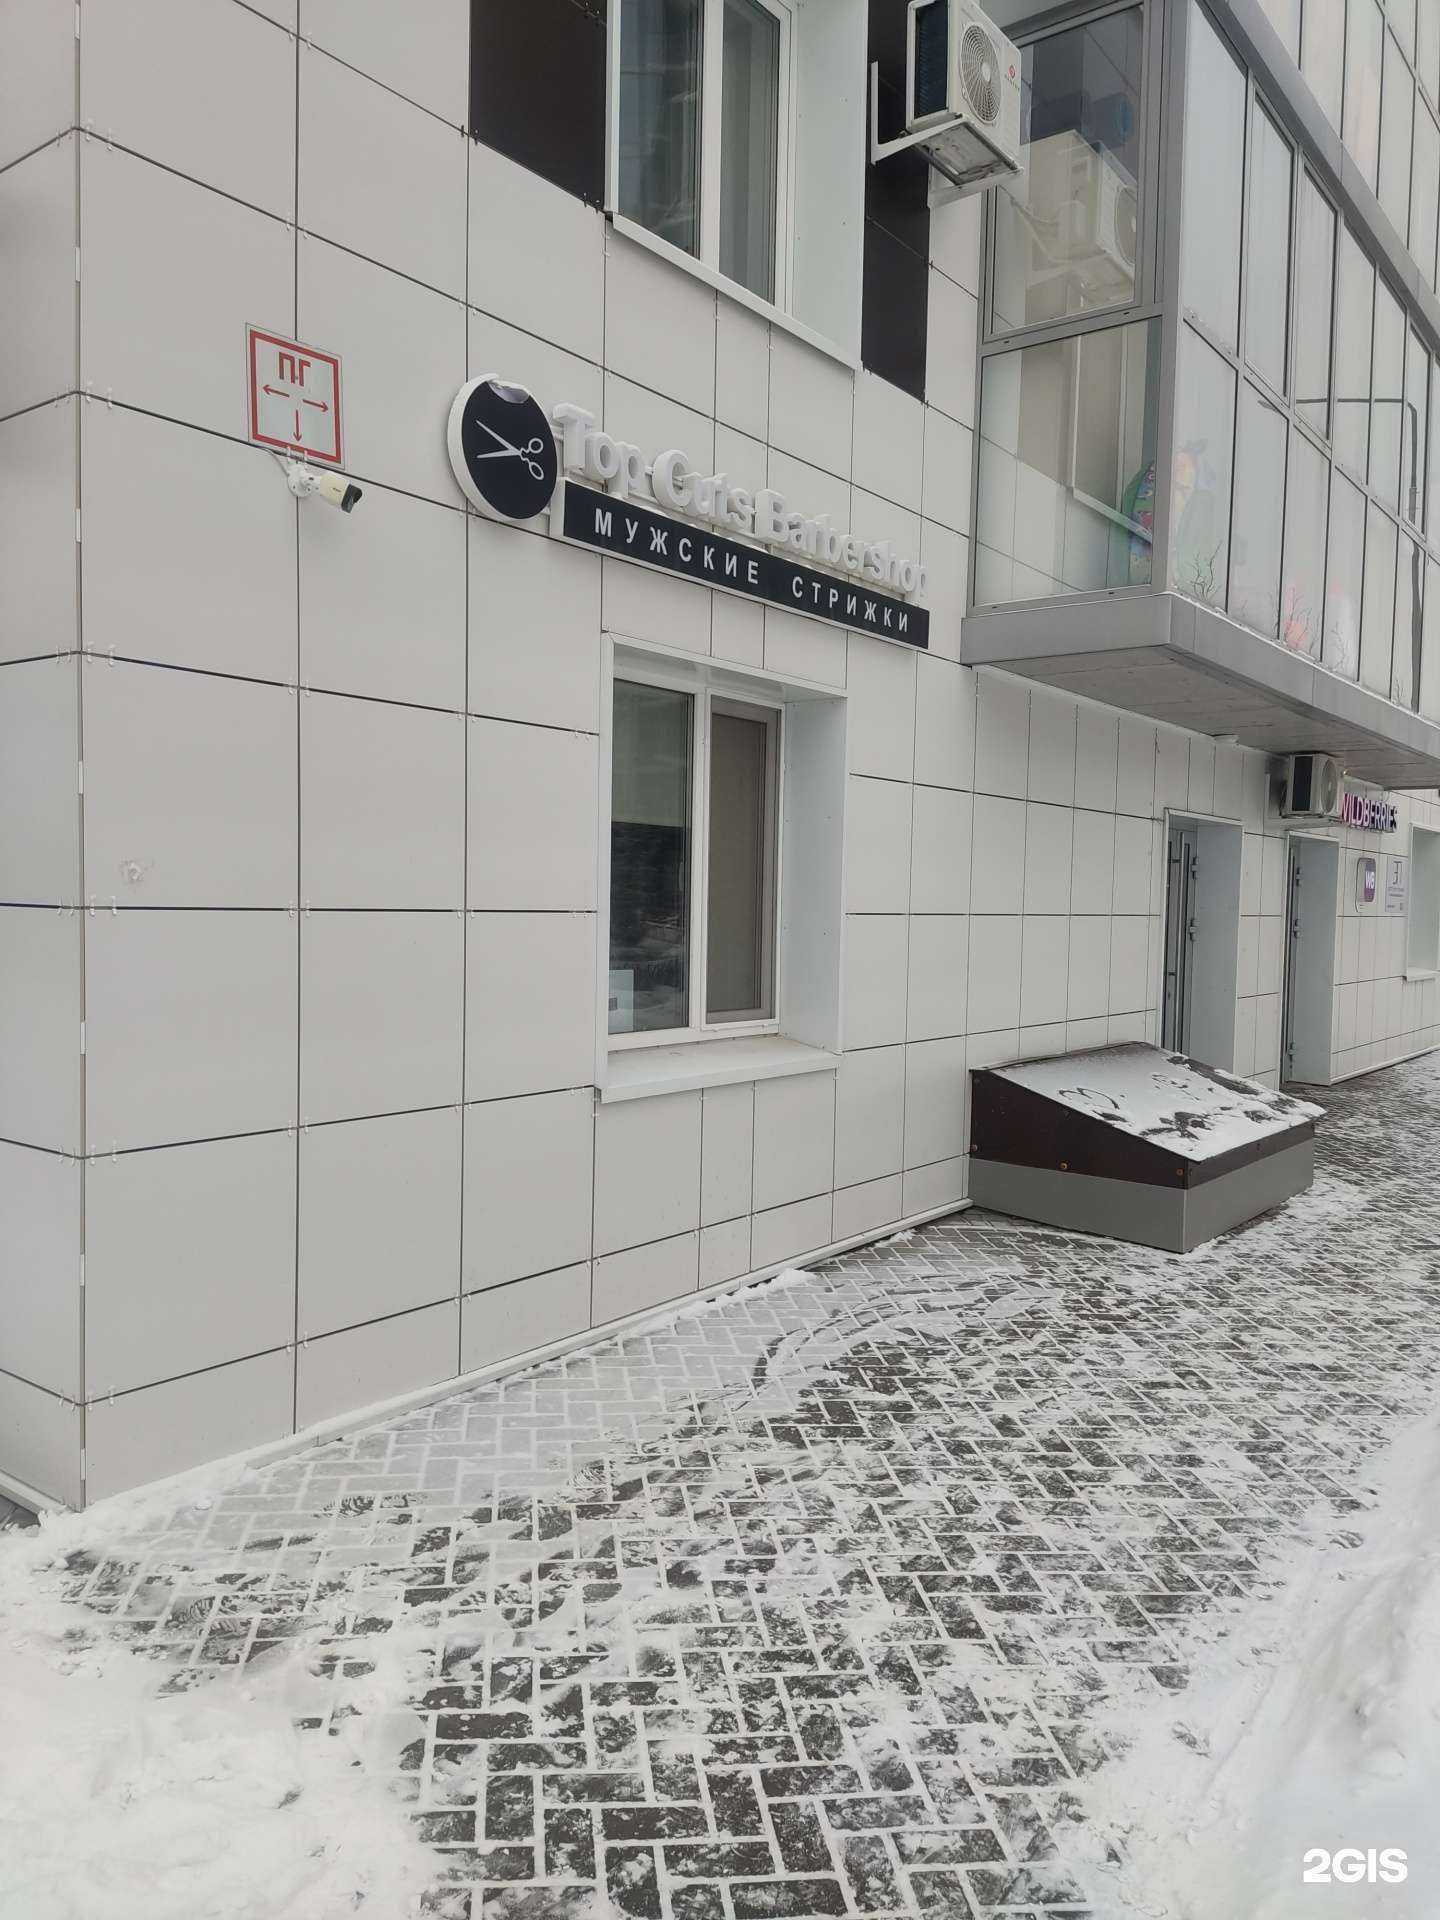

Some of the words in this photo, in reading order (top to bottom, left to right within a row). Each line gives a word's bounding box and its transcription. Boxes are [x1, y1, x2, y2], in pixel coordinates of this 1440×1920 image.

[553, 402, 645, 500] Top
[652, 449, 752, 533] Cuts
[594, 508, 759, 586] МУЖСКИЕ
[792, 576, 909, 633] СТРИЖКИ
